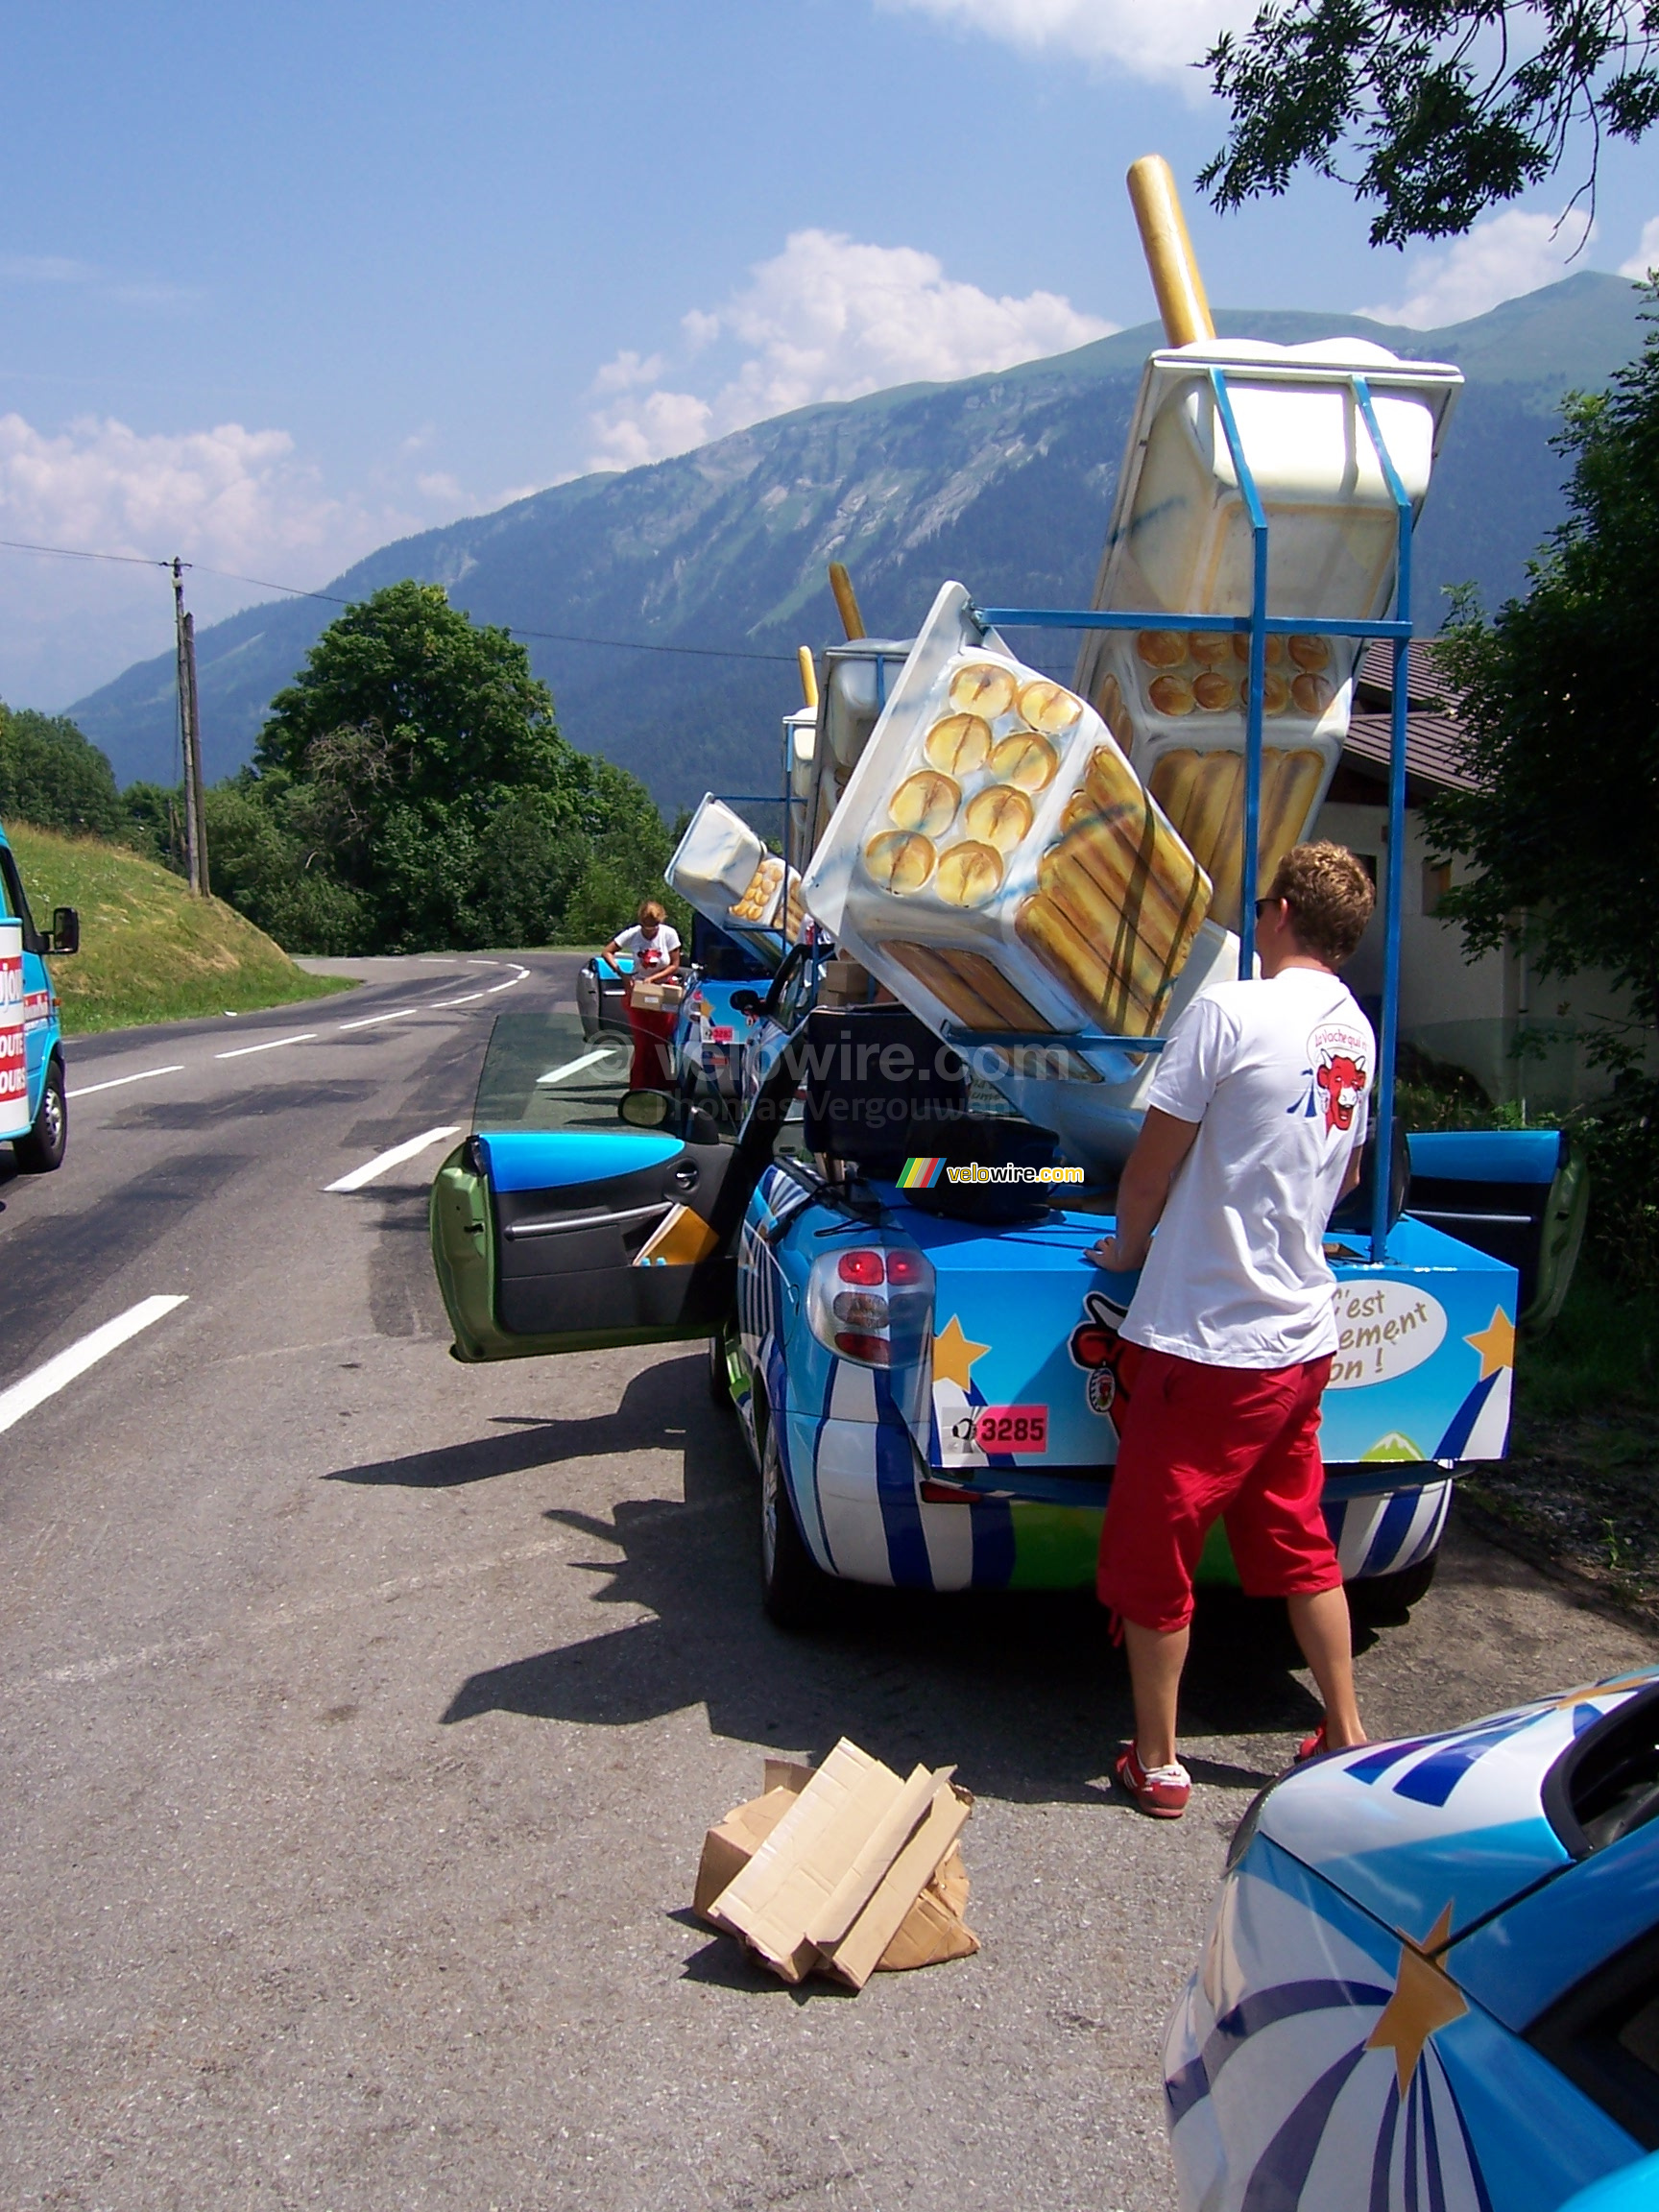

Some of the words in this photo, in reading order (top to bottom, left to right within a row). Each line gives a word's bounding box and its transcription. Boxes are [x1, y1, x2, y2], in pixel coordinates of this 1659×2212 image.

[1322, 1028, 1348, 1045] Vache
[1347, 1036, 1361, 1049] qui
[981, 1417, 1045, 1441] 3285
